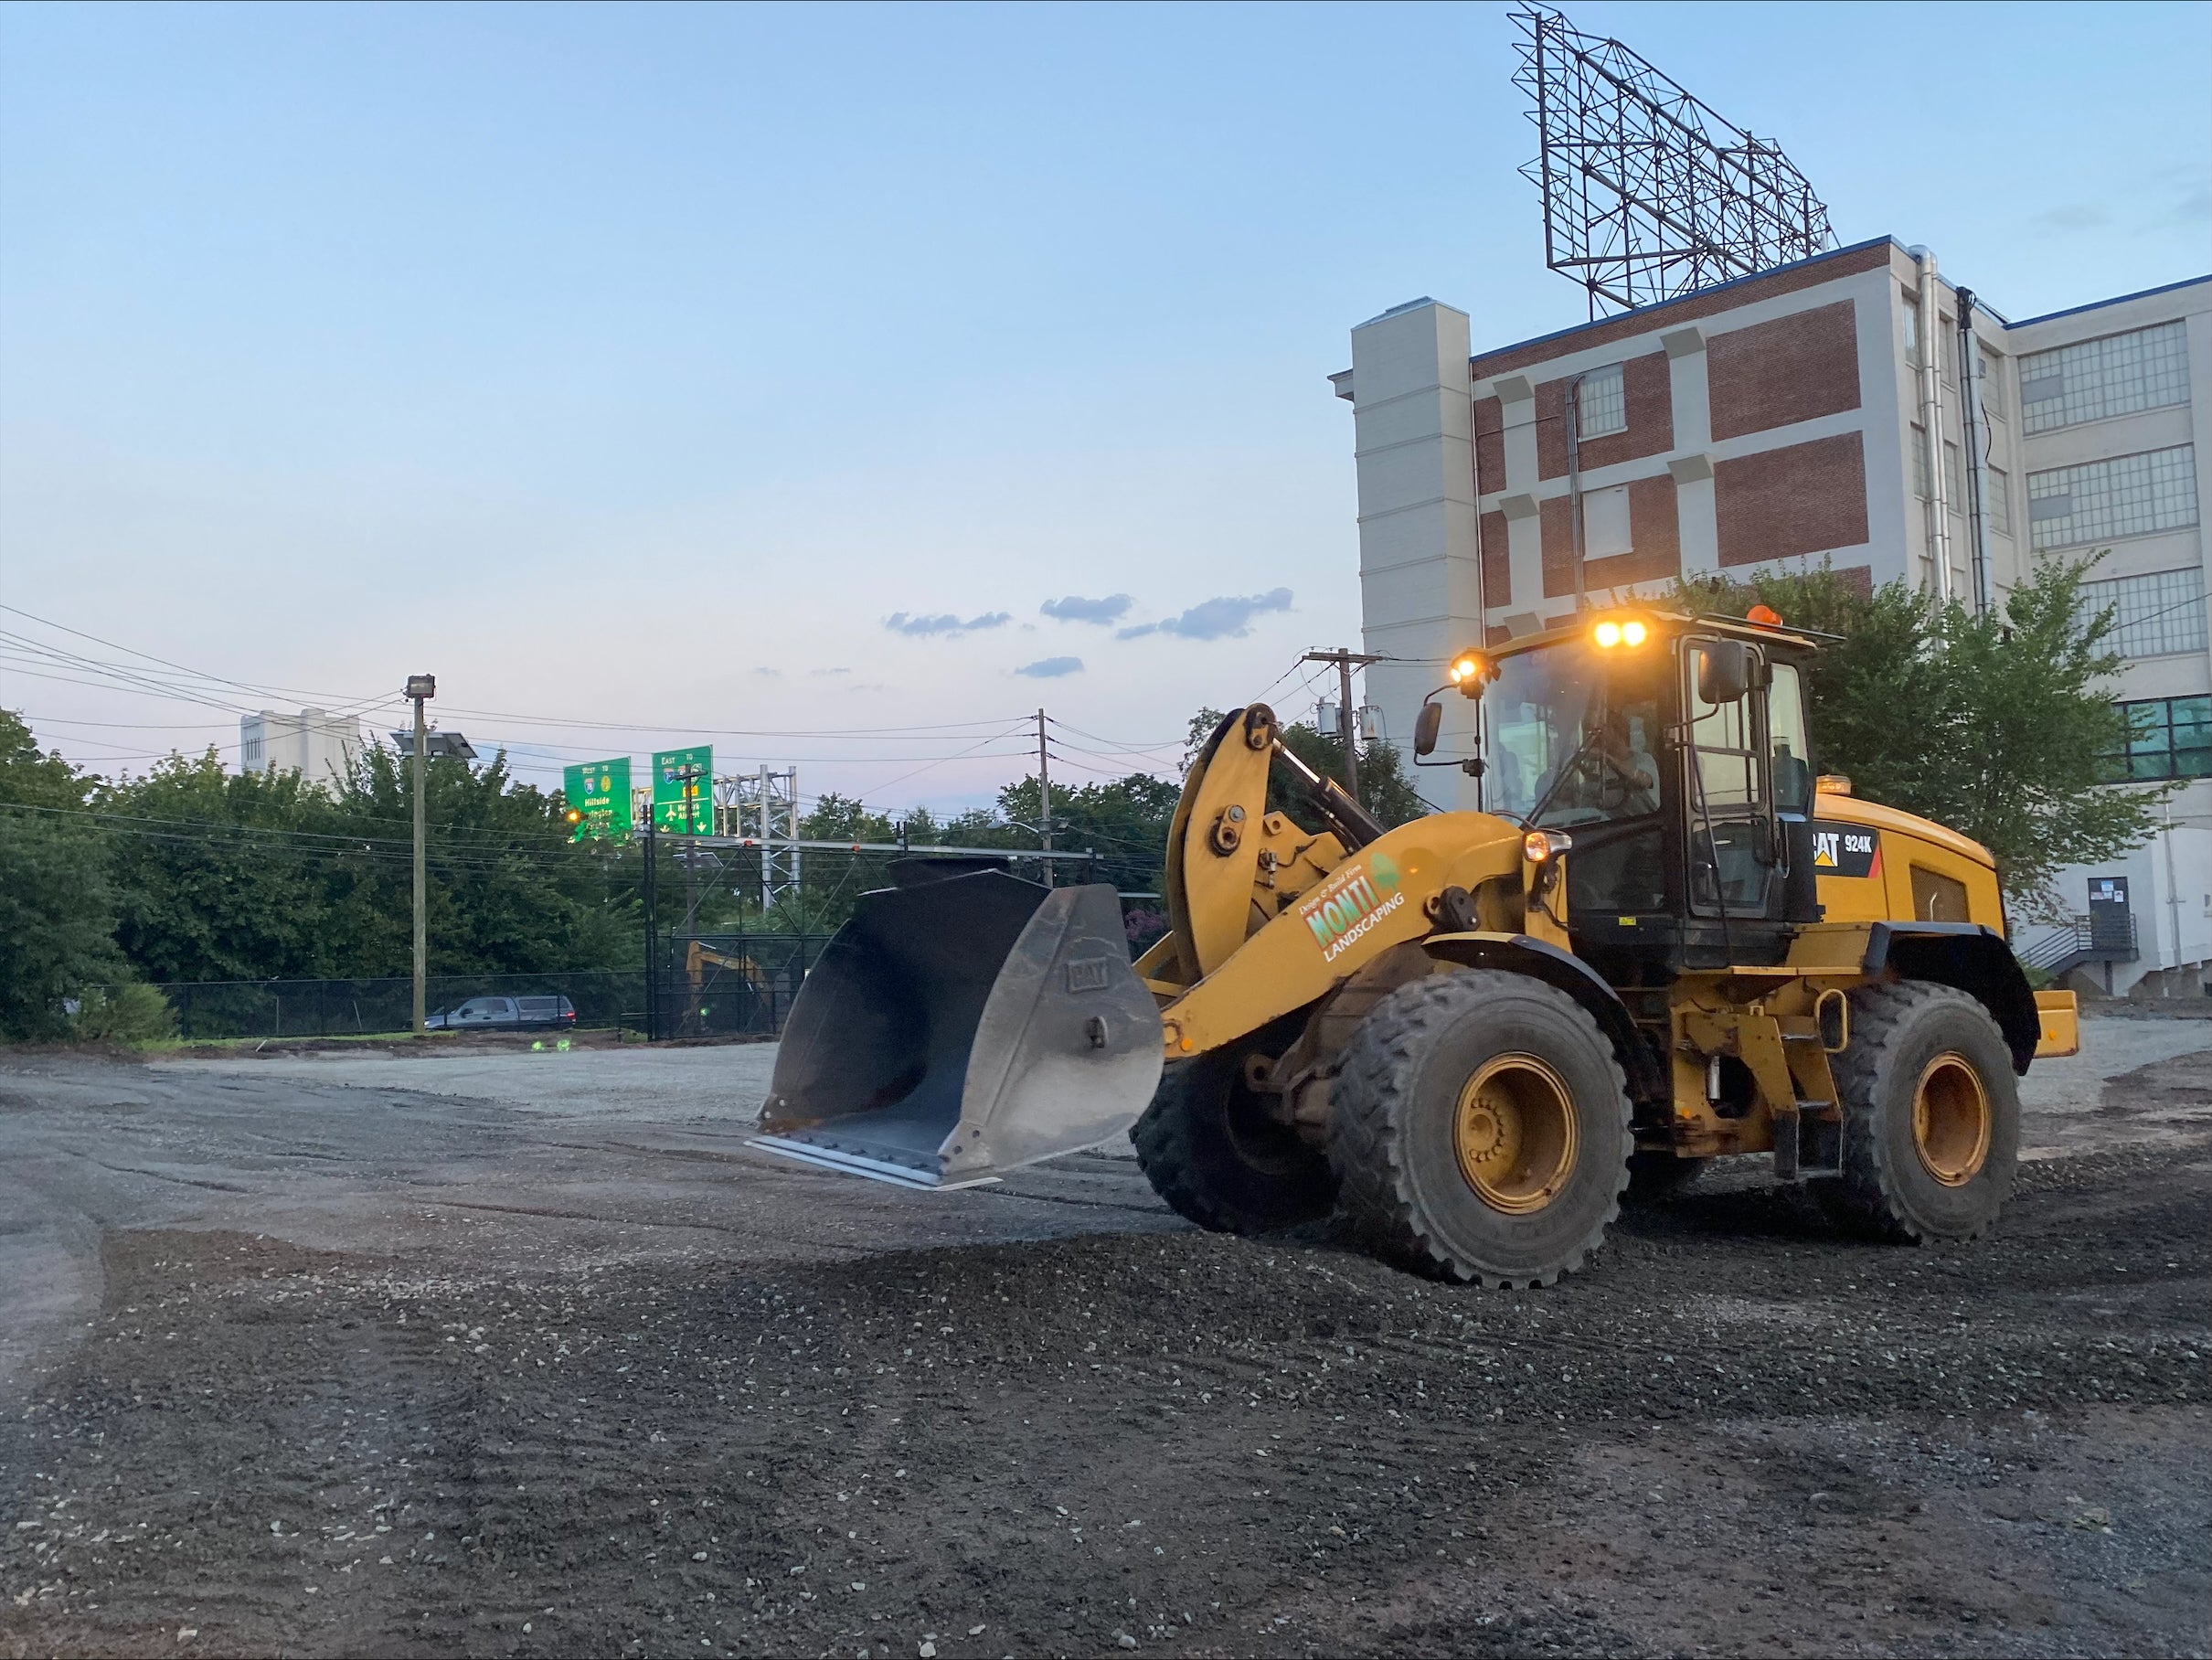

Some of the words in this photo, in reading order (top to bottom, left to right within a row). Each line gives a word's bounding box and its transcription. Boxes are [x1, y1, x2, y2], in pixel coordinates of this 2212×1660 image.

[661, 757, 675, 765] EAST
[584, 797, 610, 807] Hillside
[1845, 834, 1873, 854] 924K
[1299, 896, 1321, 915] Design
[1327, 874, 1346, 893] Build
[1306, 875, 1380, 947] MONTI
[1324, 891, 1405, 963] LANDSCAPING
